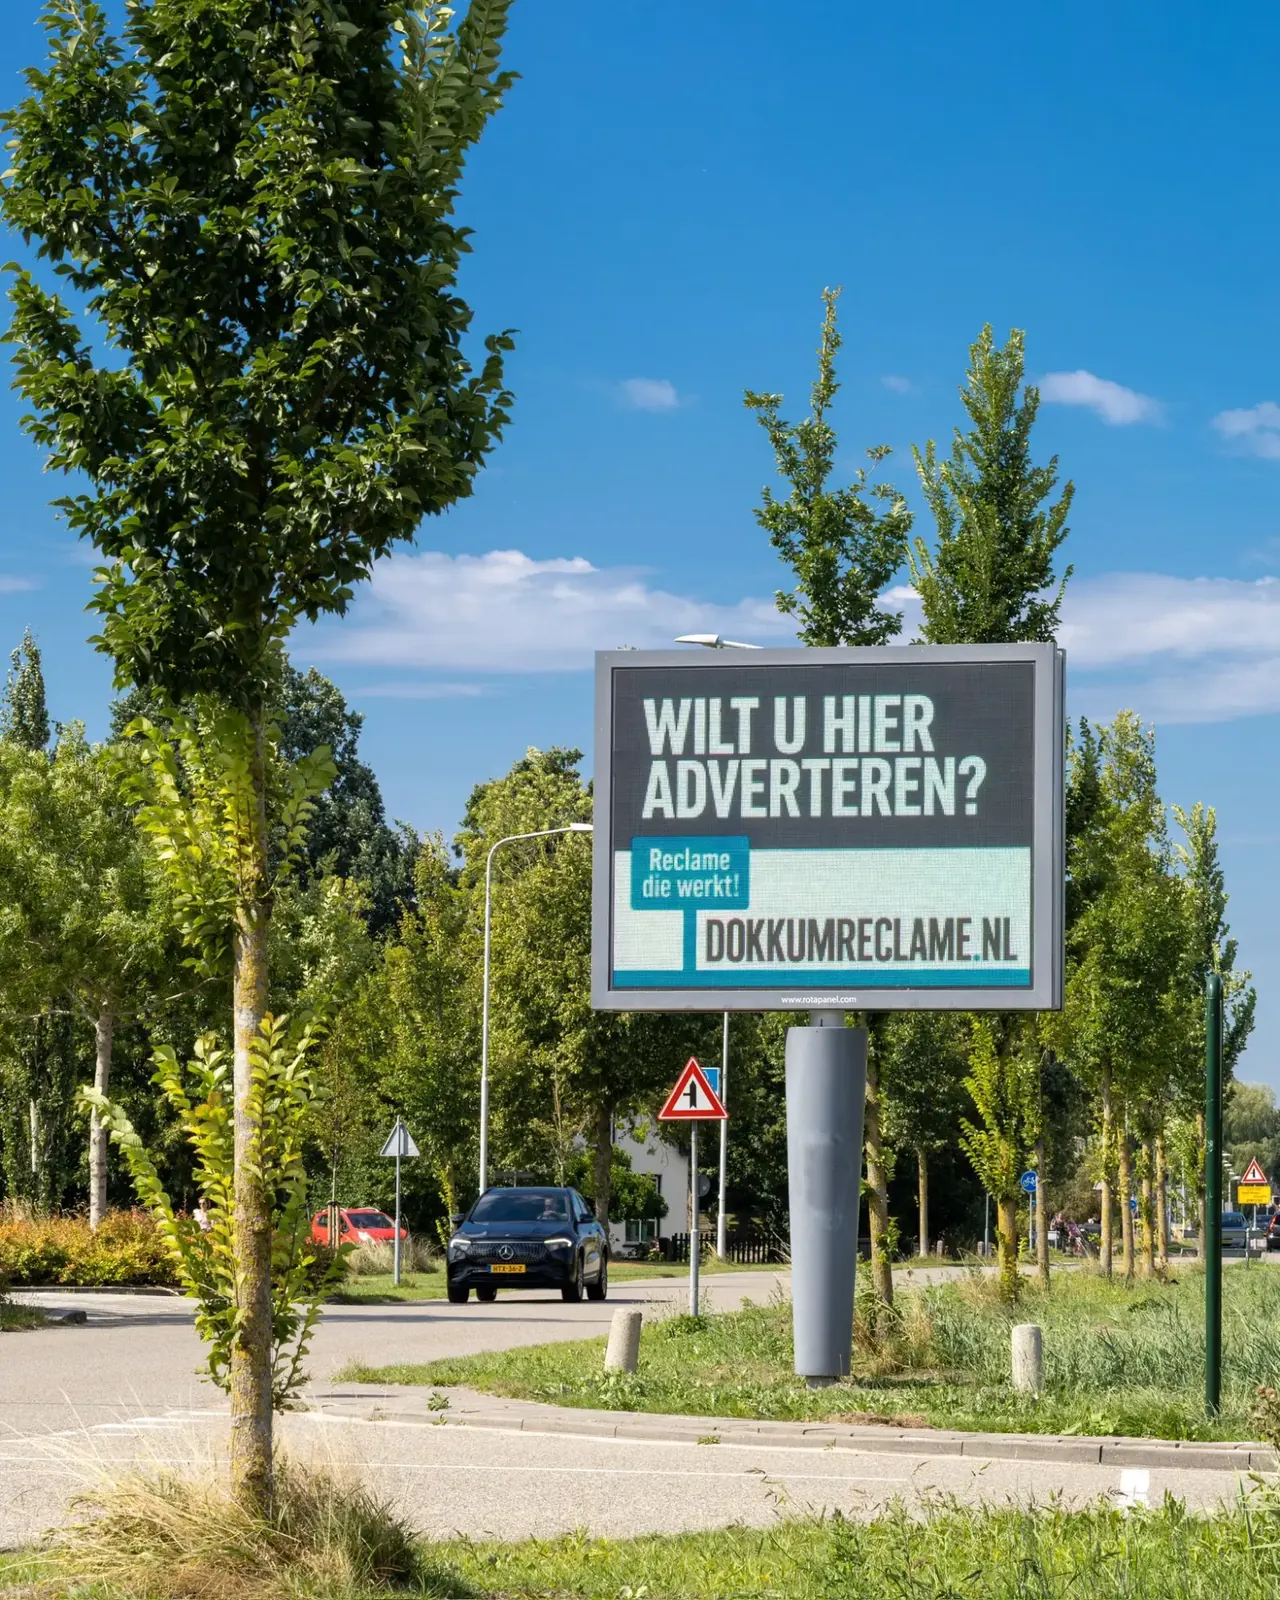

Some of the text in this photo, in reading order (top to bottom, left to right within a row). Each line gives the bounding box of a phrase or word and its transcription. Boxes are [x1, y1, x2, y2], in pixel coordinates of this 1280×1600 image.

[643, 694, 935, 755] WILT U HIER
[642, 755, 987, 819] ADVERTEREN?
[649, 848, 731, 871] Reclame
[642, 873, 740, 898] die werkt!
[706, 917, 1018, 962] DOKKUMRECLAME.NL
[781, 995, 857, 1004] www.rotapanel.com
